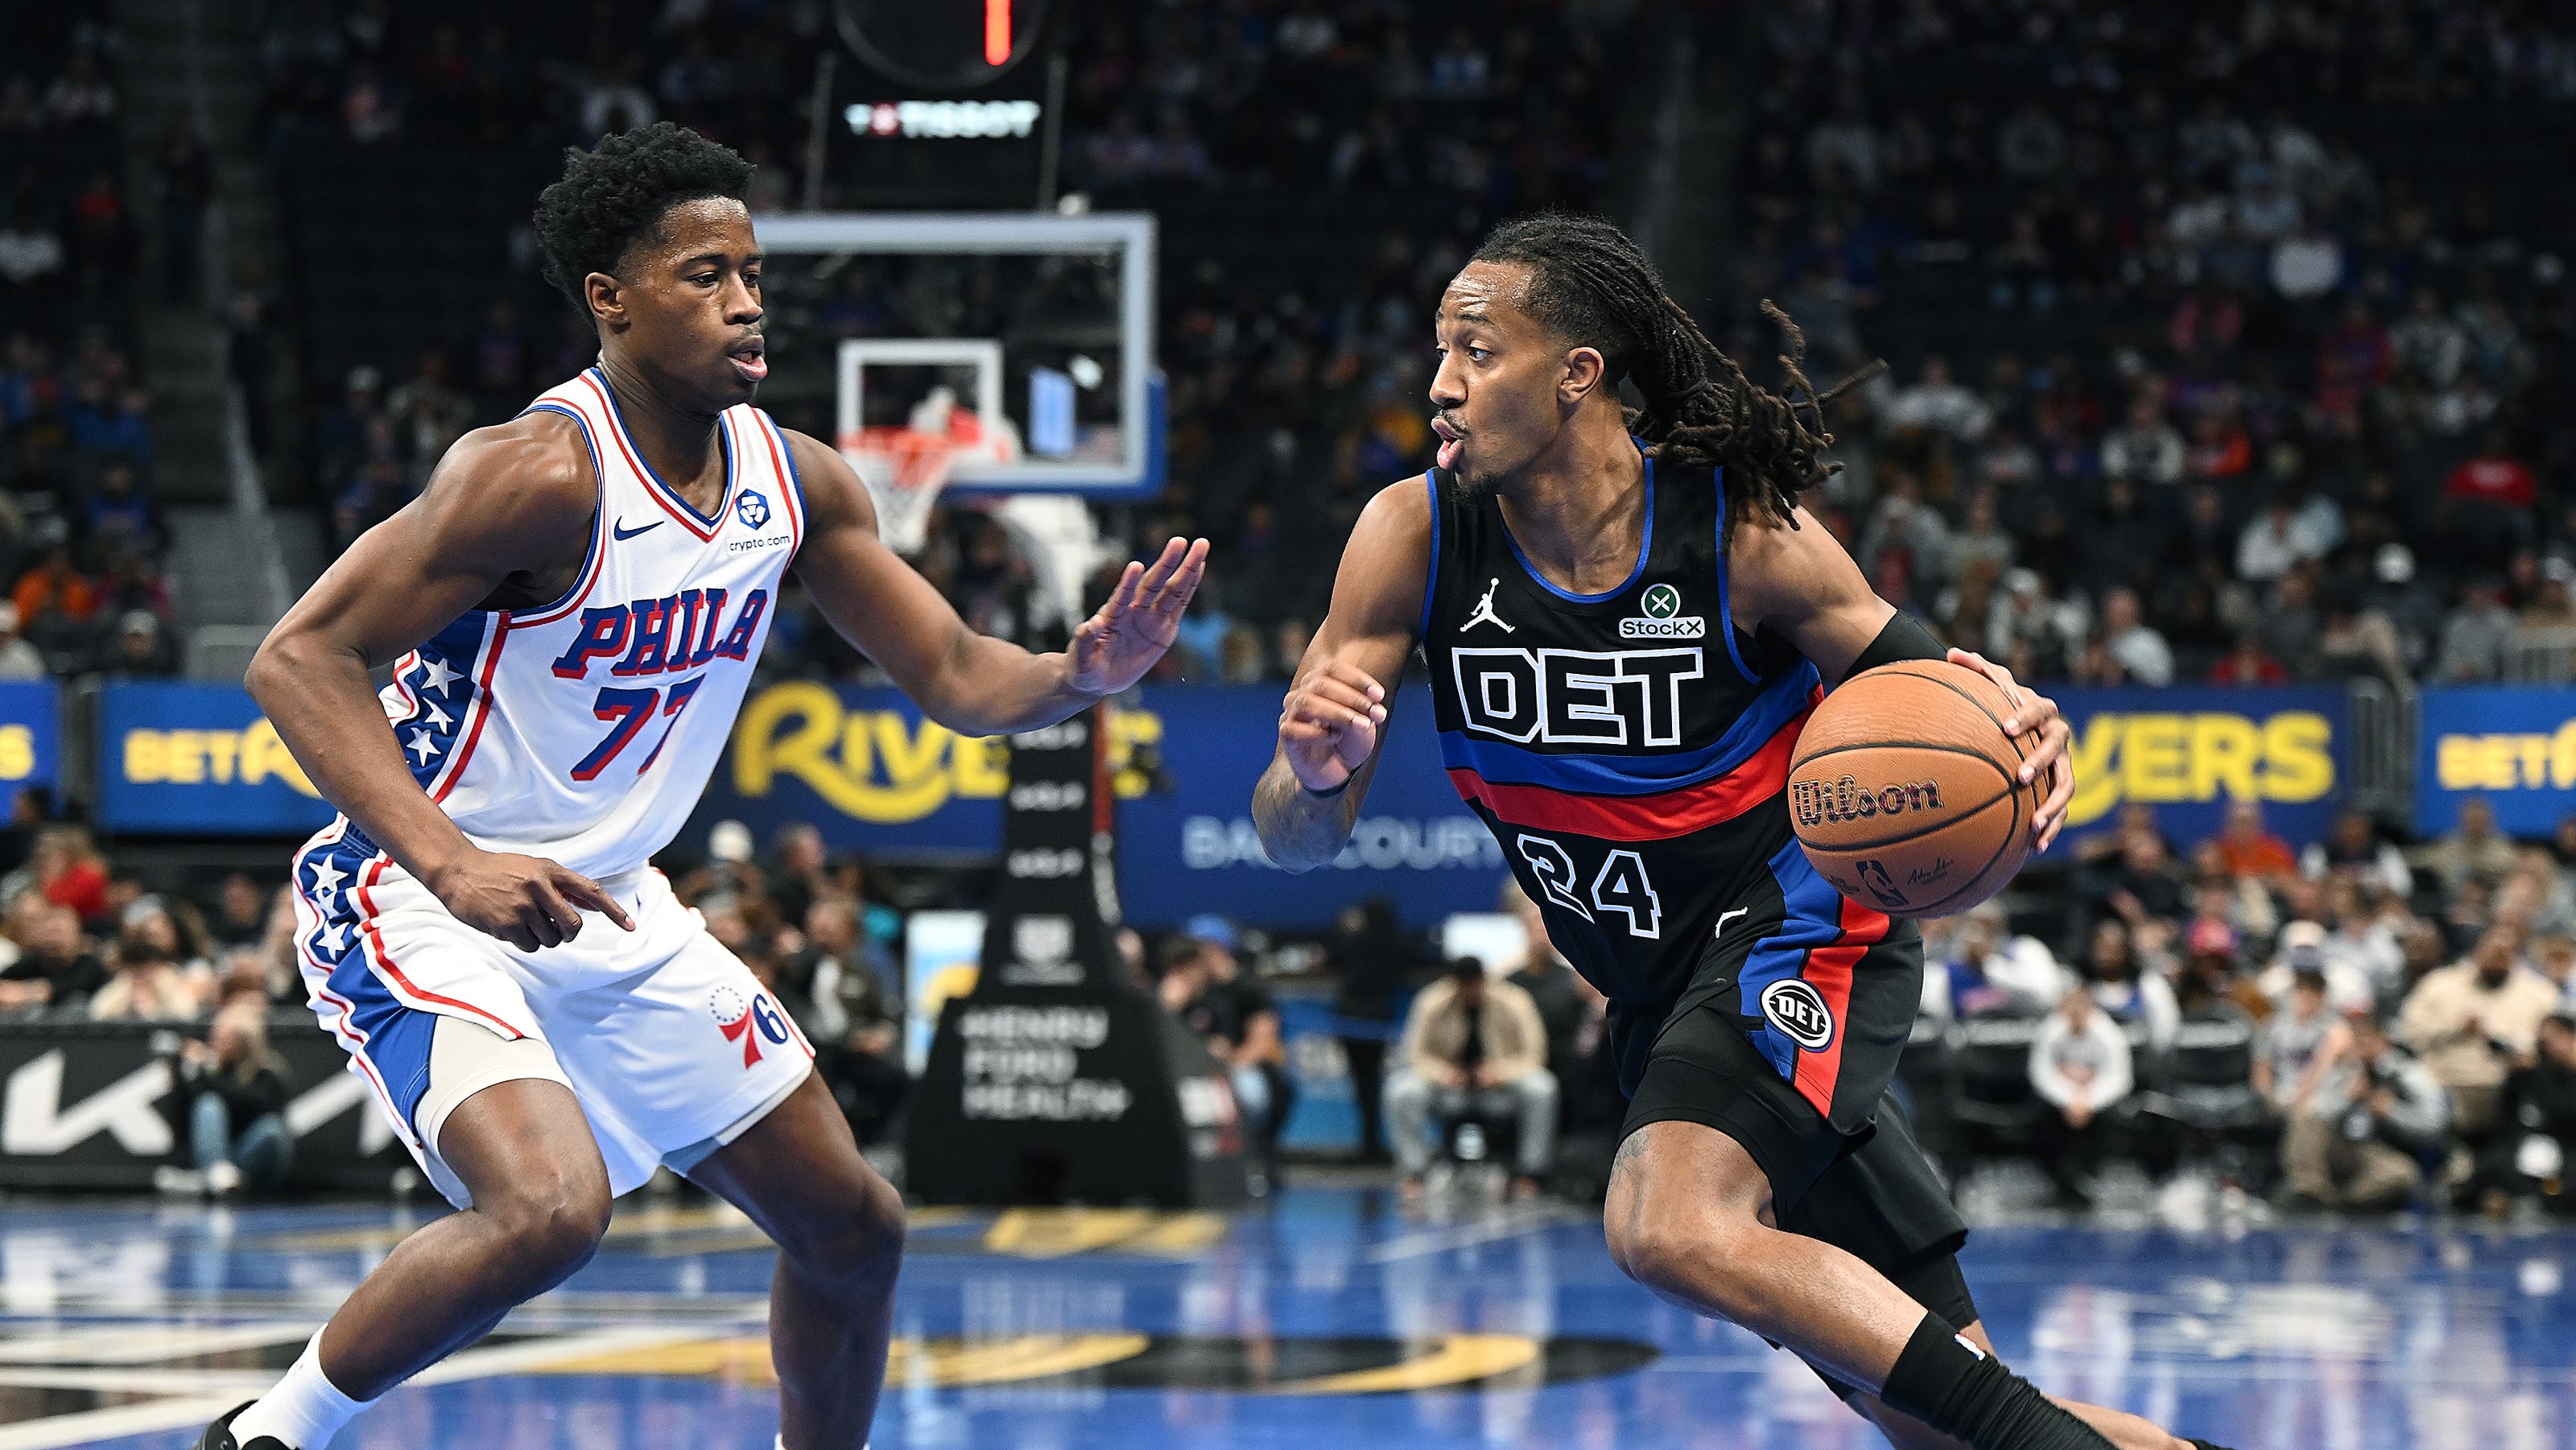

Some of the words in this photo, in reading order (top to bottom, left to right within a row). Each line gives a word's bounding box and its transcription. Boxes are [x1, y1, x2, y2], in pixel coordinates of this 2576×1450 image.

[729, 535, 791, 551] crypto.com
[551, 588, 767, 680] PHILA
[1622, 620, 1702, 635] StockX
[570, 673, 706, 781] 77
[1451, 647, 1704, 746] DET
[733, 680, 1164, 824] RIVES
[2066, 712, 2334, 828] VERS
[1793, 774, 1945, 828] Wilson
[1517, 833, 1662, 940] 24
[718, 993, 788, 1069] 76
[1775, 995, 1822, 1032] DET
